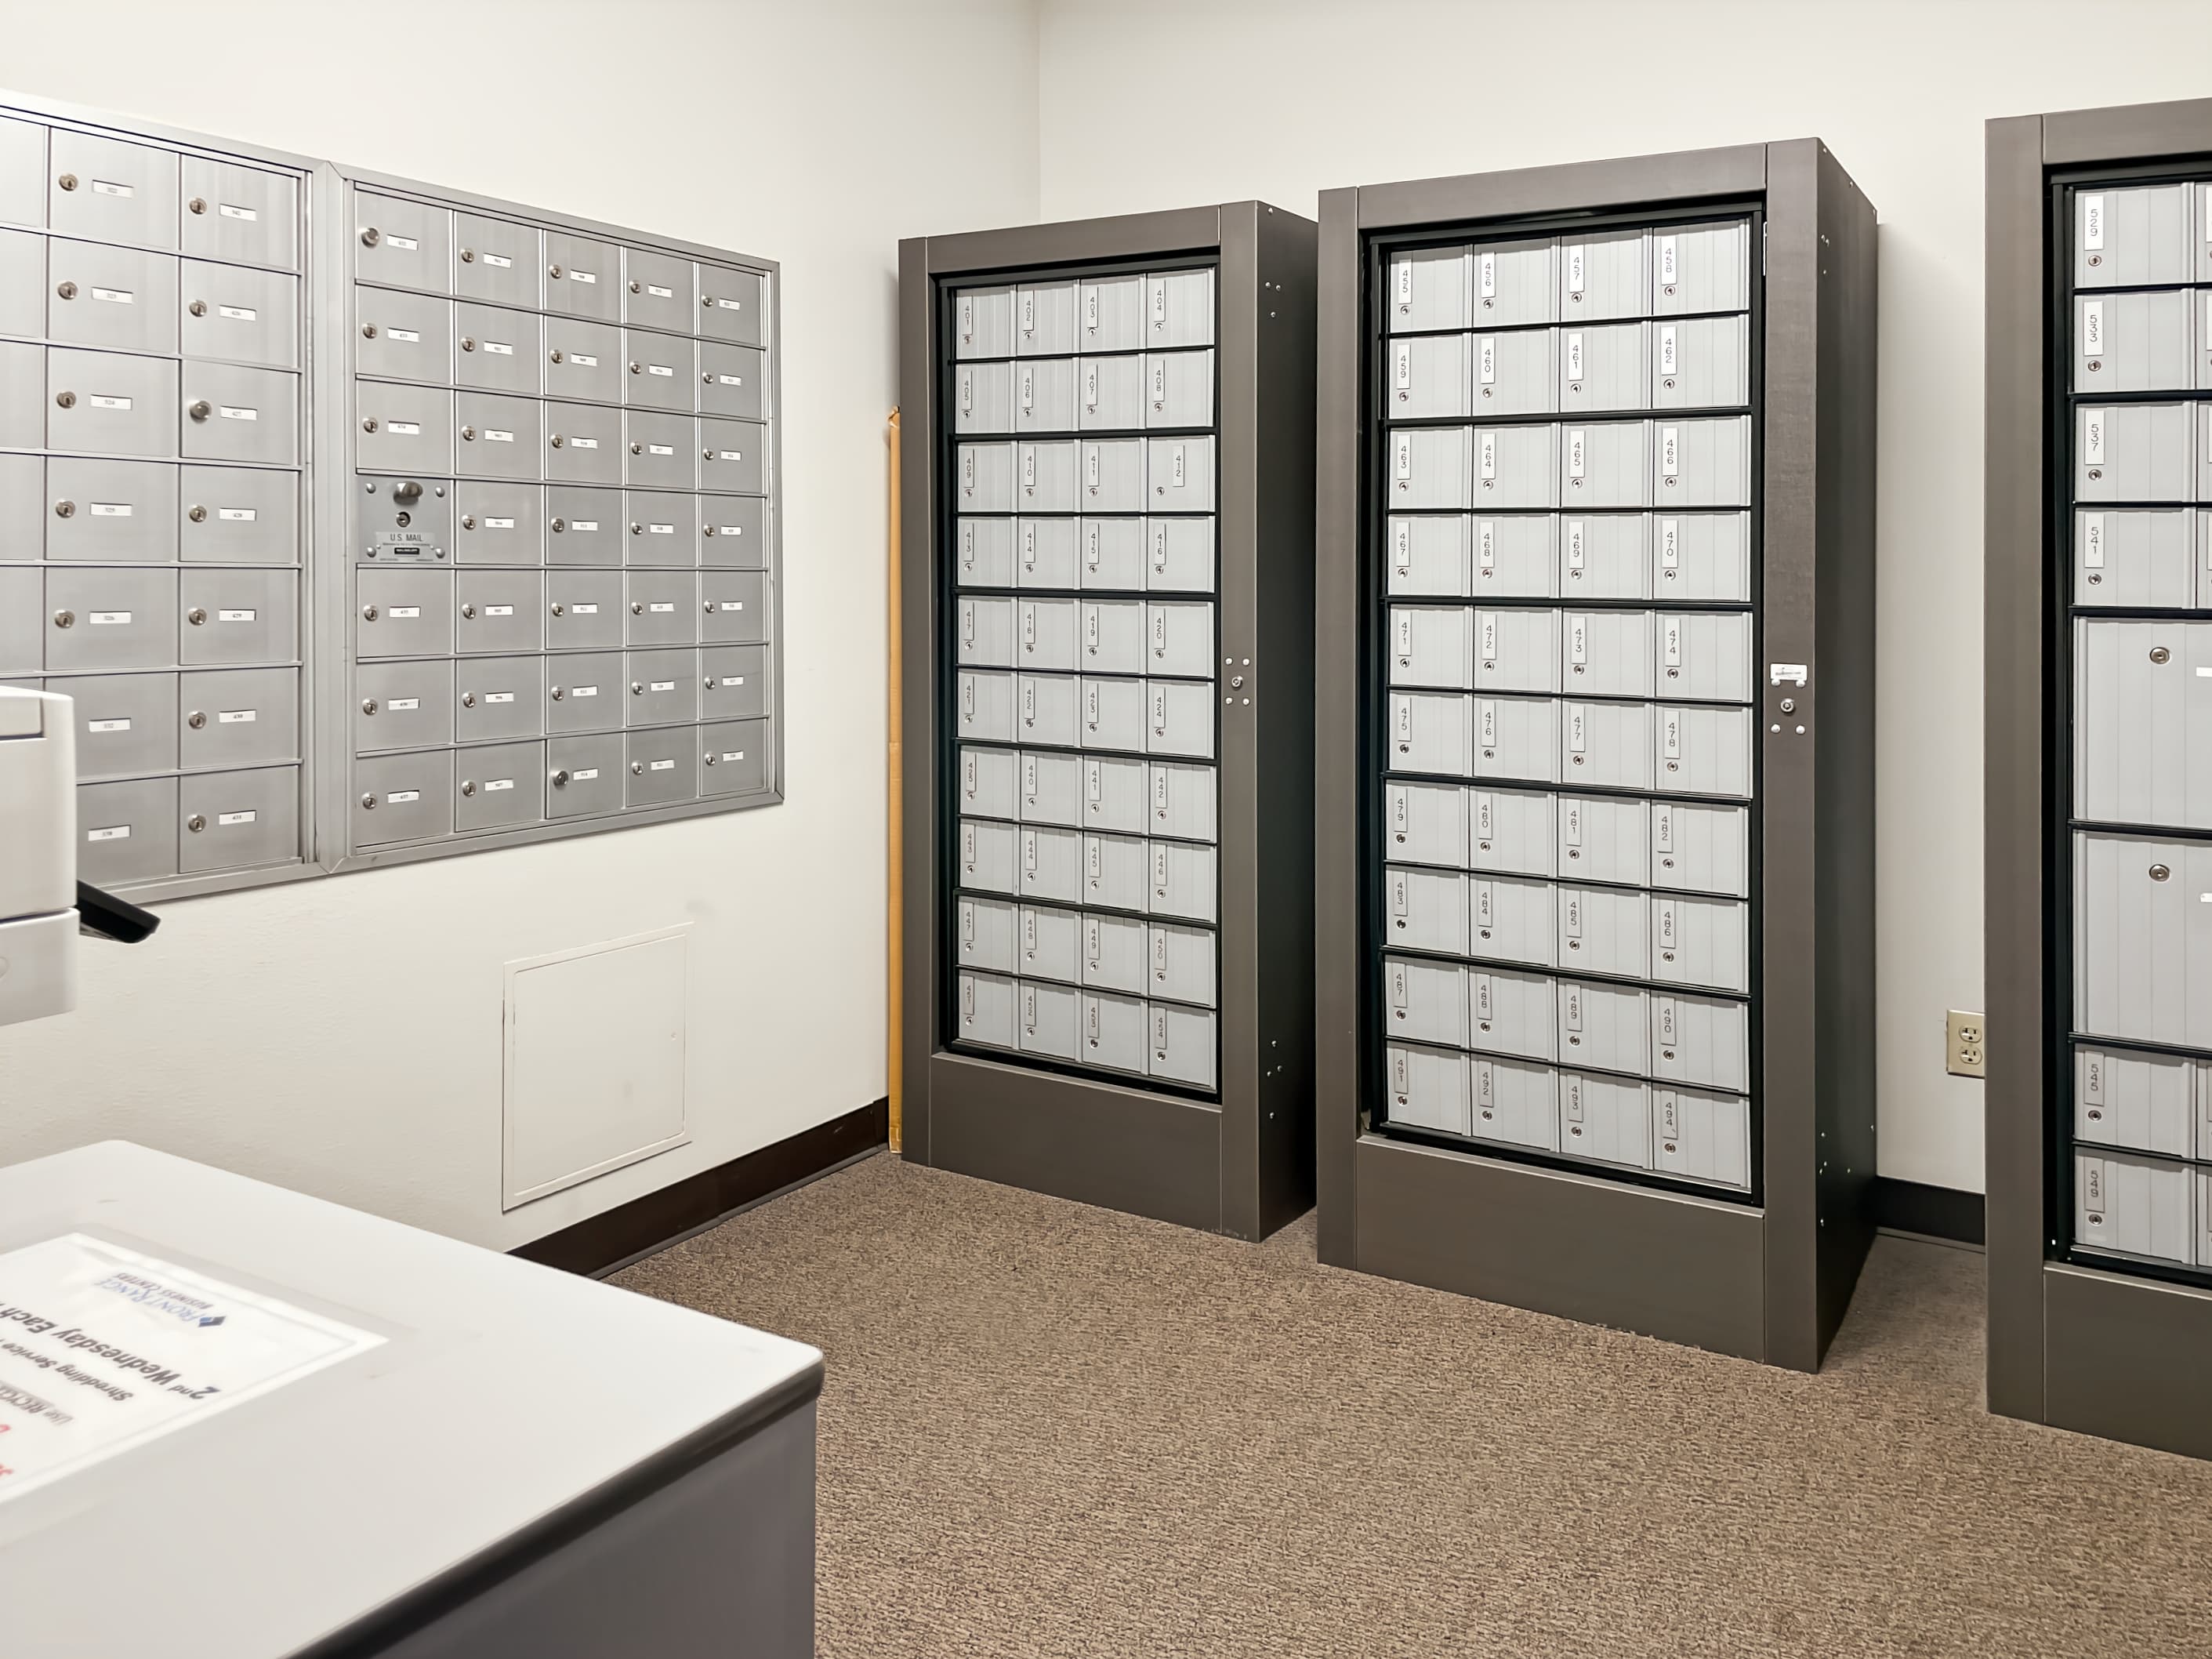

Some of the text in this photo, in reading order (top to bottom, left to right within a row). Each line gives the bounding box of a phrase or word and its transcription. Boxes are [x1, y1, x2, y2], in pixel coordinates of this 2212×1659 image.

[2090, 209, 2098, 237] 529
[2089, 314, 2098, 343] 533
[2091, 423, 2099, 452] 537
[406, 533, 424, 542] MAIL
[1666, 531, 1674, 557] 470
[2090, 526, 2099, 554] 541
[1663, 1007, 1672, 1033] 490
[2090, 1063, 2099, 1092] 545
[2090, 1170, 2099, 1198] 549
[159, 1289, 214, 1309] BUSINESS
[0, 1307, 220, 1399] 2nd Wednesday Each
[2, 1342, 134, 1401] Shredding Service
